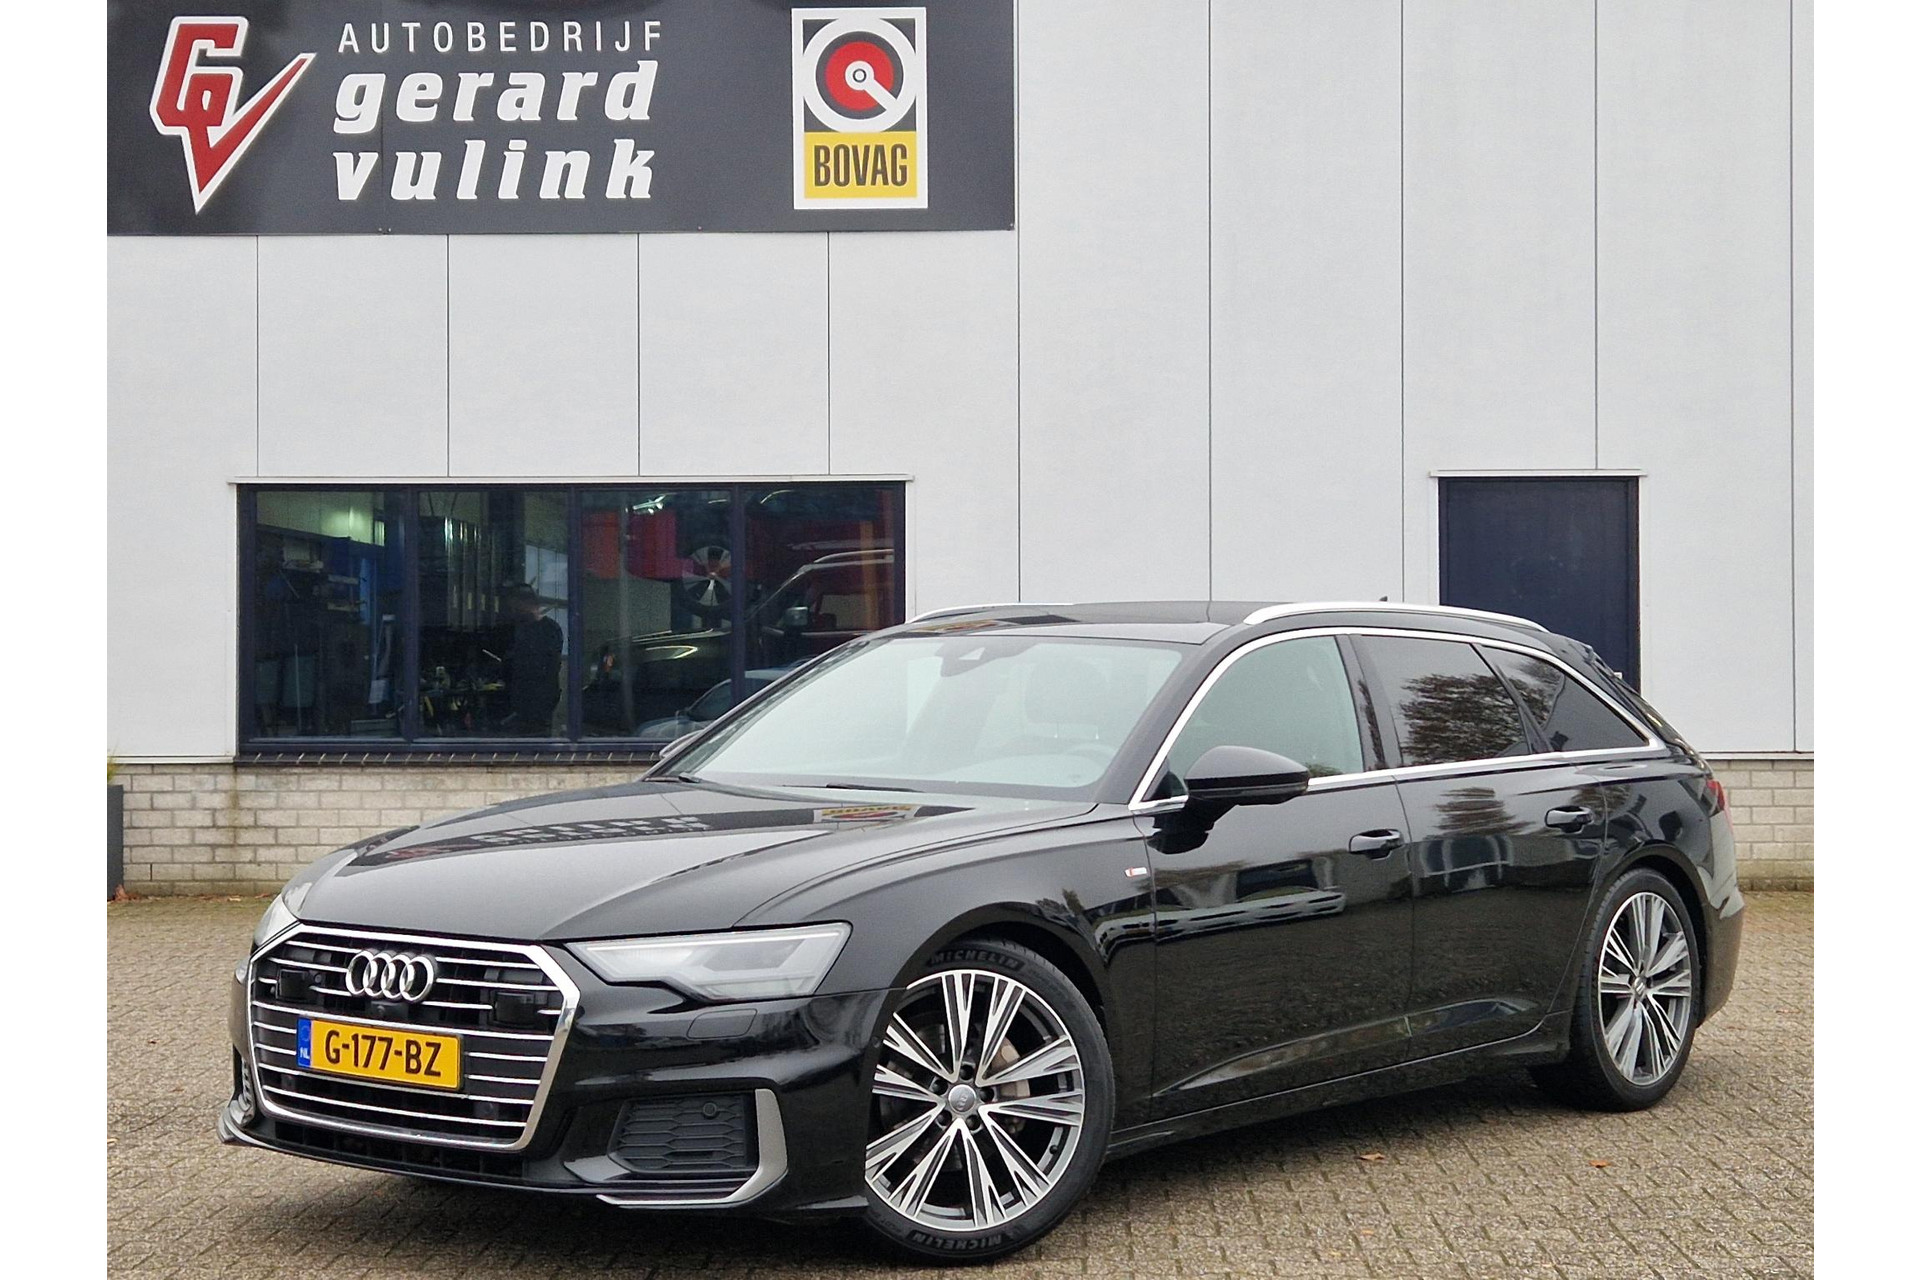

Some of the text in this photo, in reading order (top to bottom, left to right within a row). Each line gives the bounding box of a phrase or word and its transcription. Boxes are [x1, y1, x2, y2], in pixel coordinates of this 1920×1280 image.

[338, 21, 662, 53] AUTOBEDRIJF
[333, 60, 658, 134] gerard
[333, 139, 656, 200] vulink
[813, 143, 908, 188] BOVAG
[931, 950, 1019, 968] MICHELIN
[300, 1048, 310, 1059] NL
[325, 1030, 441, 1077] G-177-BZ
[913, 1232, 1001, 1249] MICHELIN
